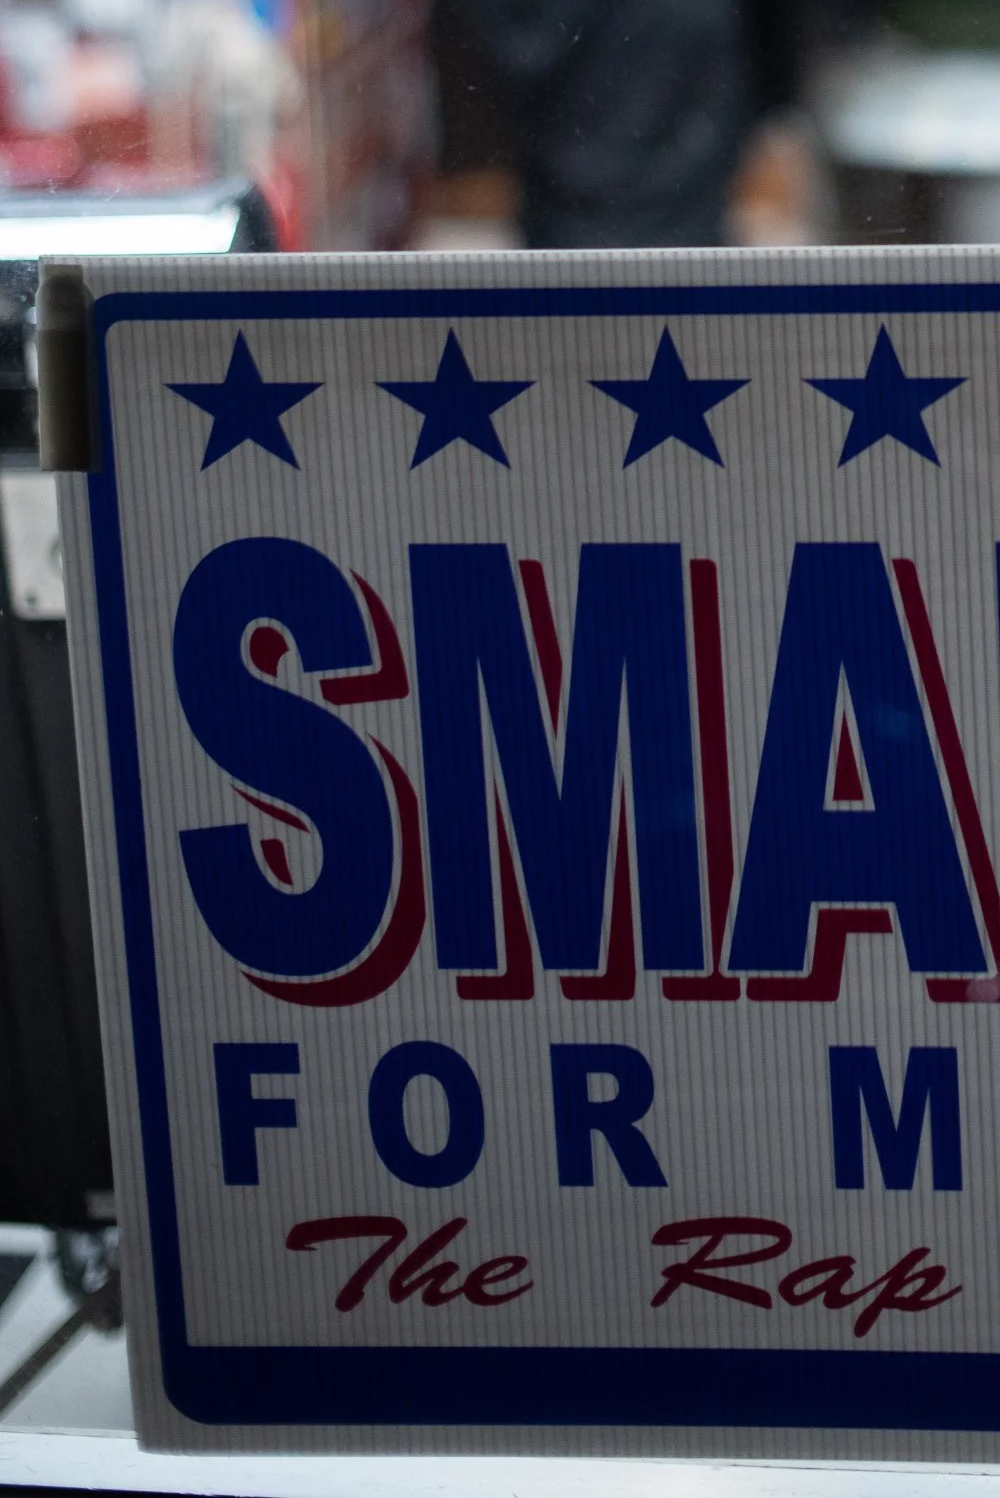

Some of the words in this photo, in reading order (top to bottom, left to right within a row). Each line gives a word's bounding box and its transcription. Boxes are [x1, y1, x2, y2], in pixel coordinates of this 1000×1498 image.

[212, 1039, 670, 1189] FOR
[285, 1214, 534, 1314] The
[650, 1216, 962, 1338] Rap
